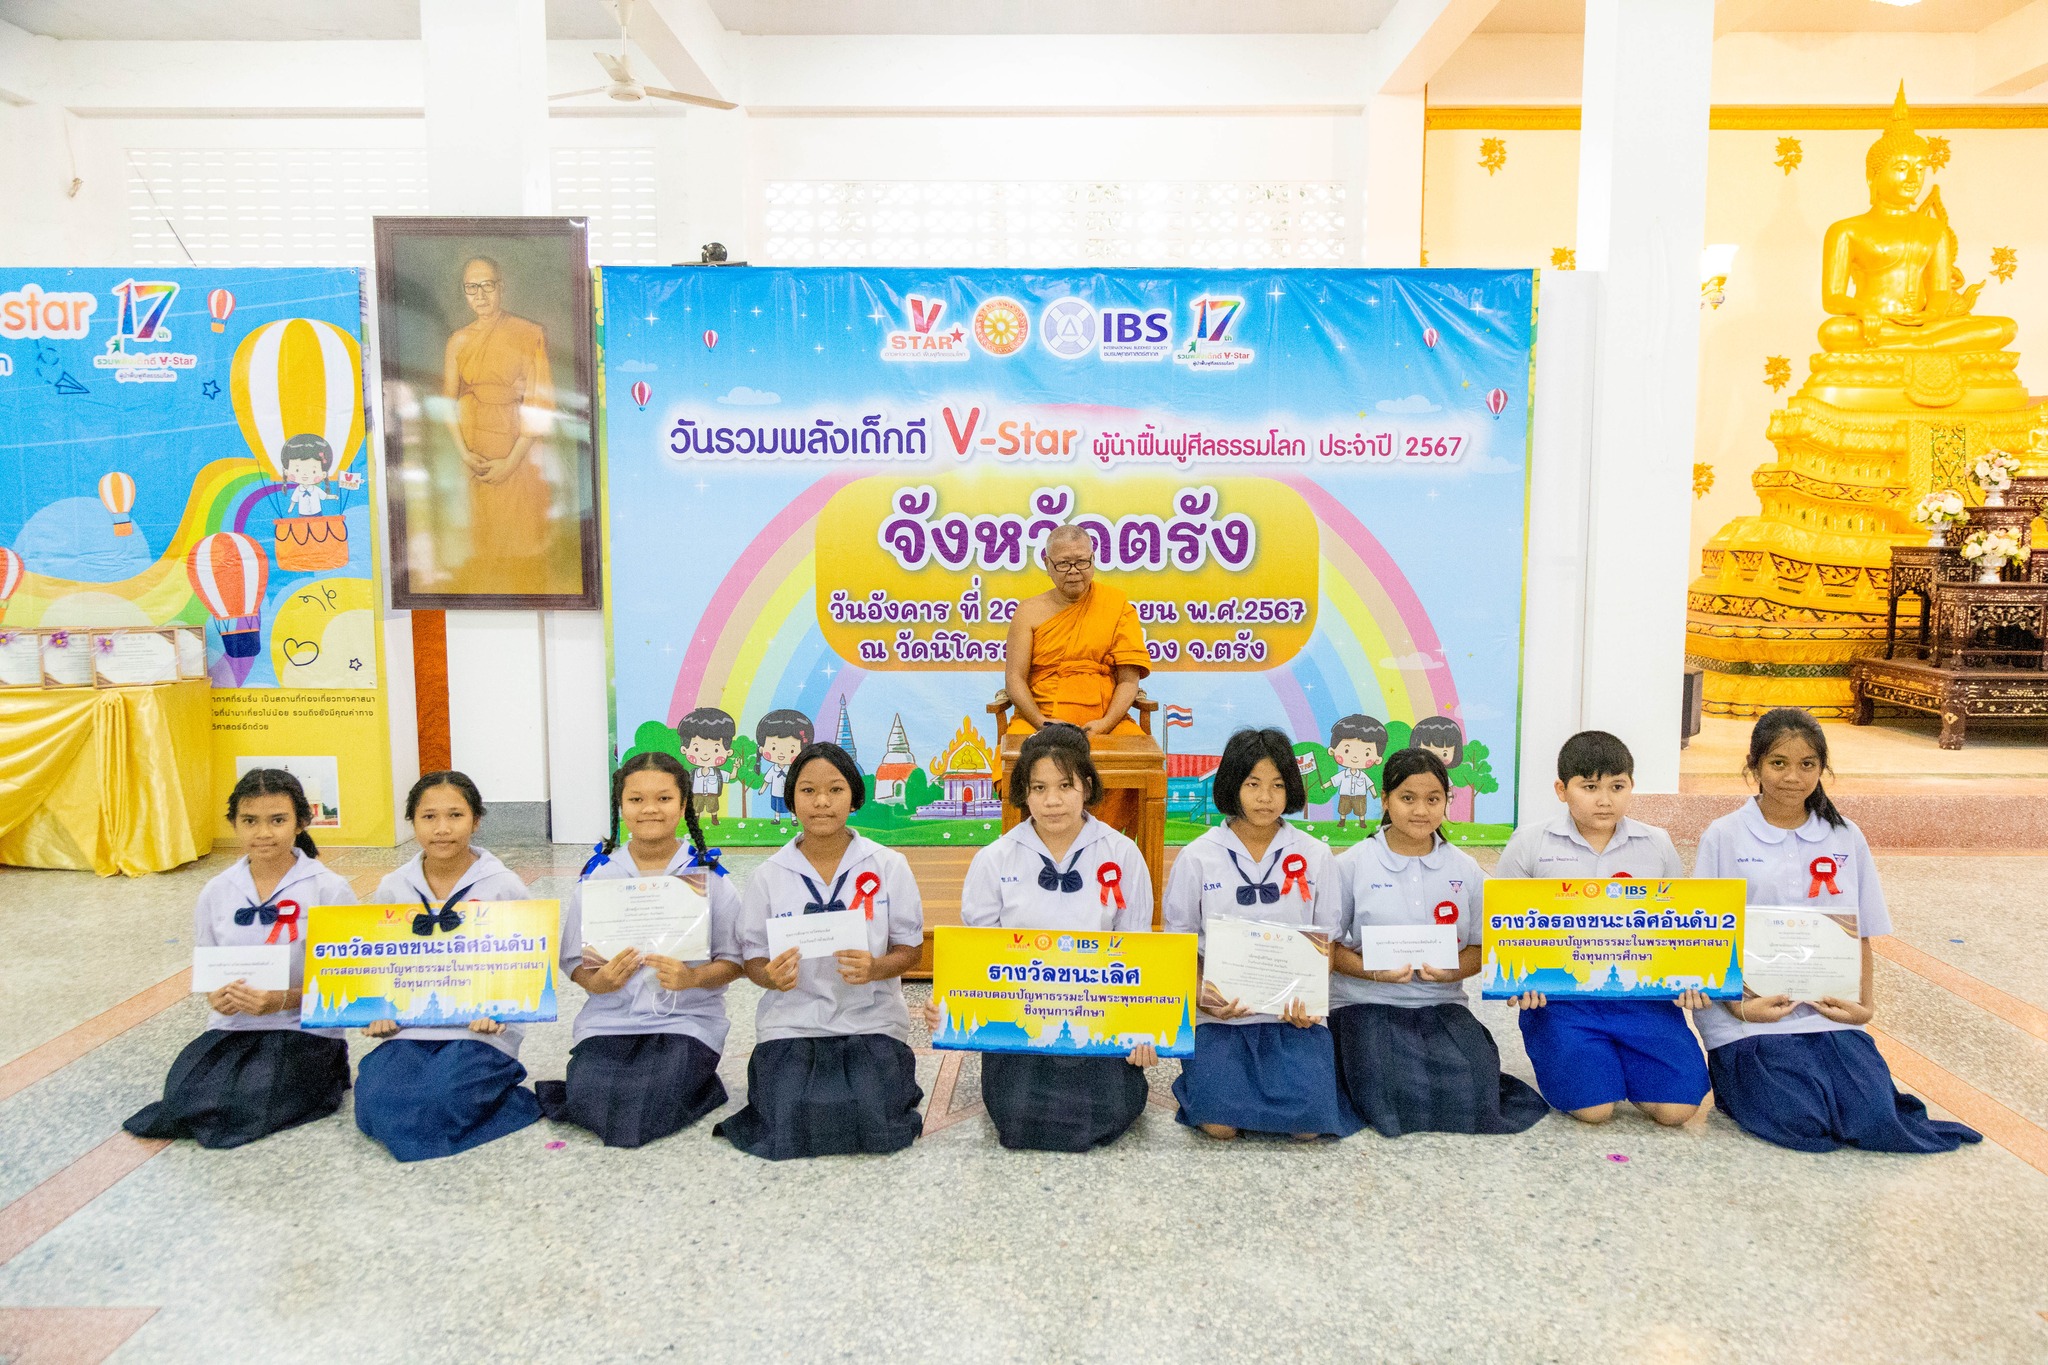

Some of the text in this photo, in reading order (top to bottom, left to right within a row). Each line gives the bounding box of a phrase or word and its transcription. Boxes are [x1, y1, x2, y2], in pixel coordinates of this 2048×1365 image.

[0, 293, 89, 331] star
[911, 299, 942, 334] V
[1104, 313, 1168, 342] IBS
[891, 336, 953, 350] STAR
[670, 407, 1462, 463] วันรวมพลังเด็กดี V-Star ผู้นำฟื้นฟูศีลธรรมโลก ประจำปี 2567
[829, 592, 950, 621] วันอังคาร
[959, 577, 979, 620] ที่
[1187, 600, 1305, 621] พ.ศ.2567
[860, 641, 887, 660] ณ
[1188, 631, 1265, 660] จ.ตรัง
[1625, 886, 1647, 895] IBS
[1491, 910, 1735, 929] รางวัลรองชนะเลิศอันดับ 2
[315, 934, 546, 957] รางวัลรองชนะเลิศอันดับ 1
[1077, 939, 1099, 949] IBS
[1498, 934, 1729, 950] การสอบตอบปัญหาธรรมะในพระพุทธศาสนา
[1572, 950, 1653, 964] ชิงทุนการศึกษา
[320, 959, 544, 977] การสอบตอบปัญหาธรรมะในพระพุทธศาสนา
[989, 961, 1140, 985] รางวัลชนะเลิศ
[393, 975, 472, 992] ชิงทุนการศึกษา
[949, 988, 1181, 1008] การสอบตอบปัญหาธรรมะในพระพุทธศาสนา
[1024, 1005, 1105, 1020] ชิงทุนการศึกษา
